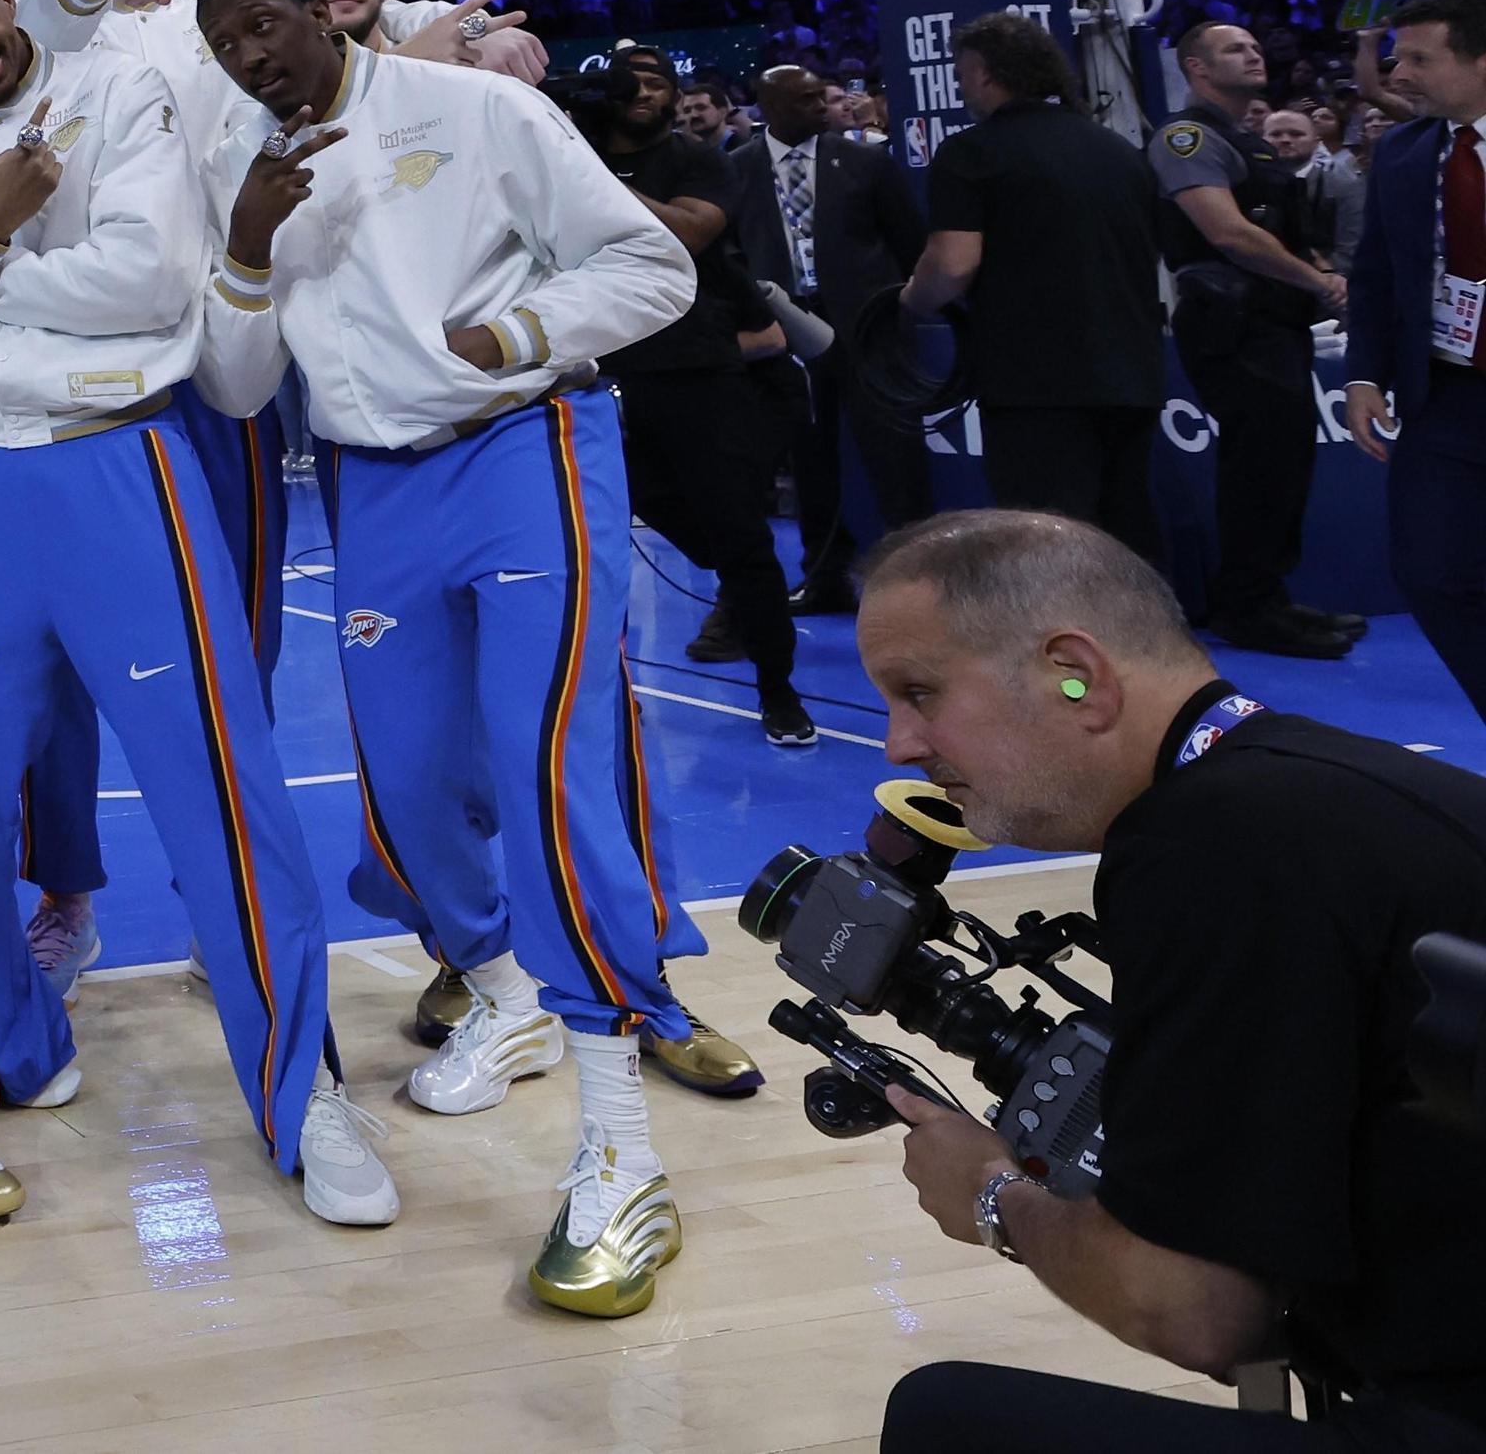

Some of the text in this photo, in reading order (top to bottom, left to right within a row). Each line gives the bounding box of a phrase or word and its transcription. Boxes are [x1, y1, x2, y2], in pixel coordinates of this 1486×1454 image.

[905, 12, 955, 62] GET
[909, 63, 964, 111] THE
[351, 617, 375, 637] OKC
[821, 922, 857, 973] AMIRA
